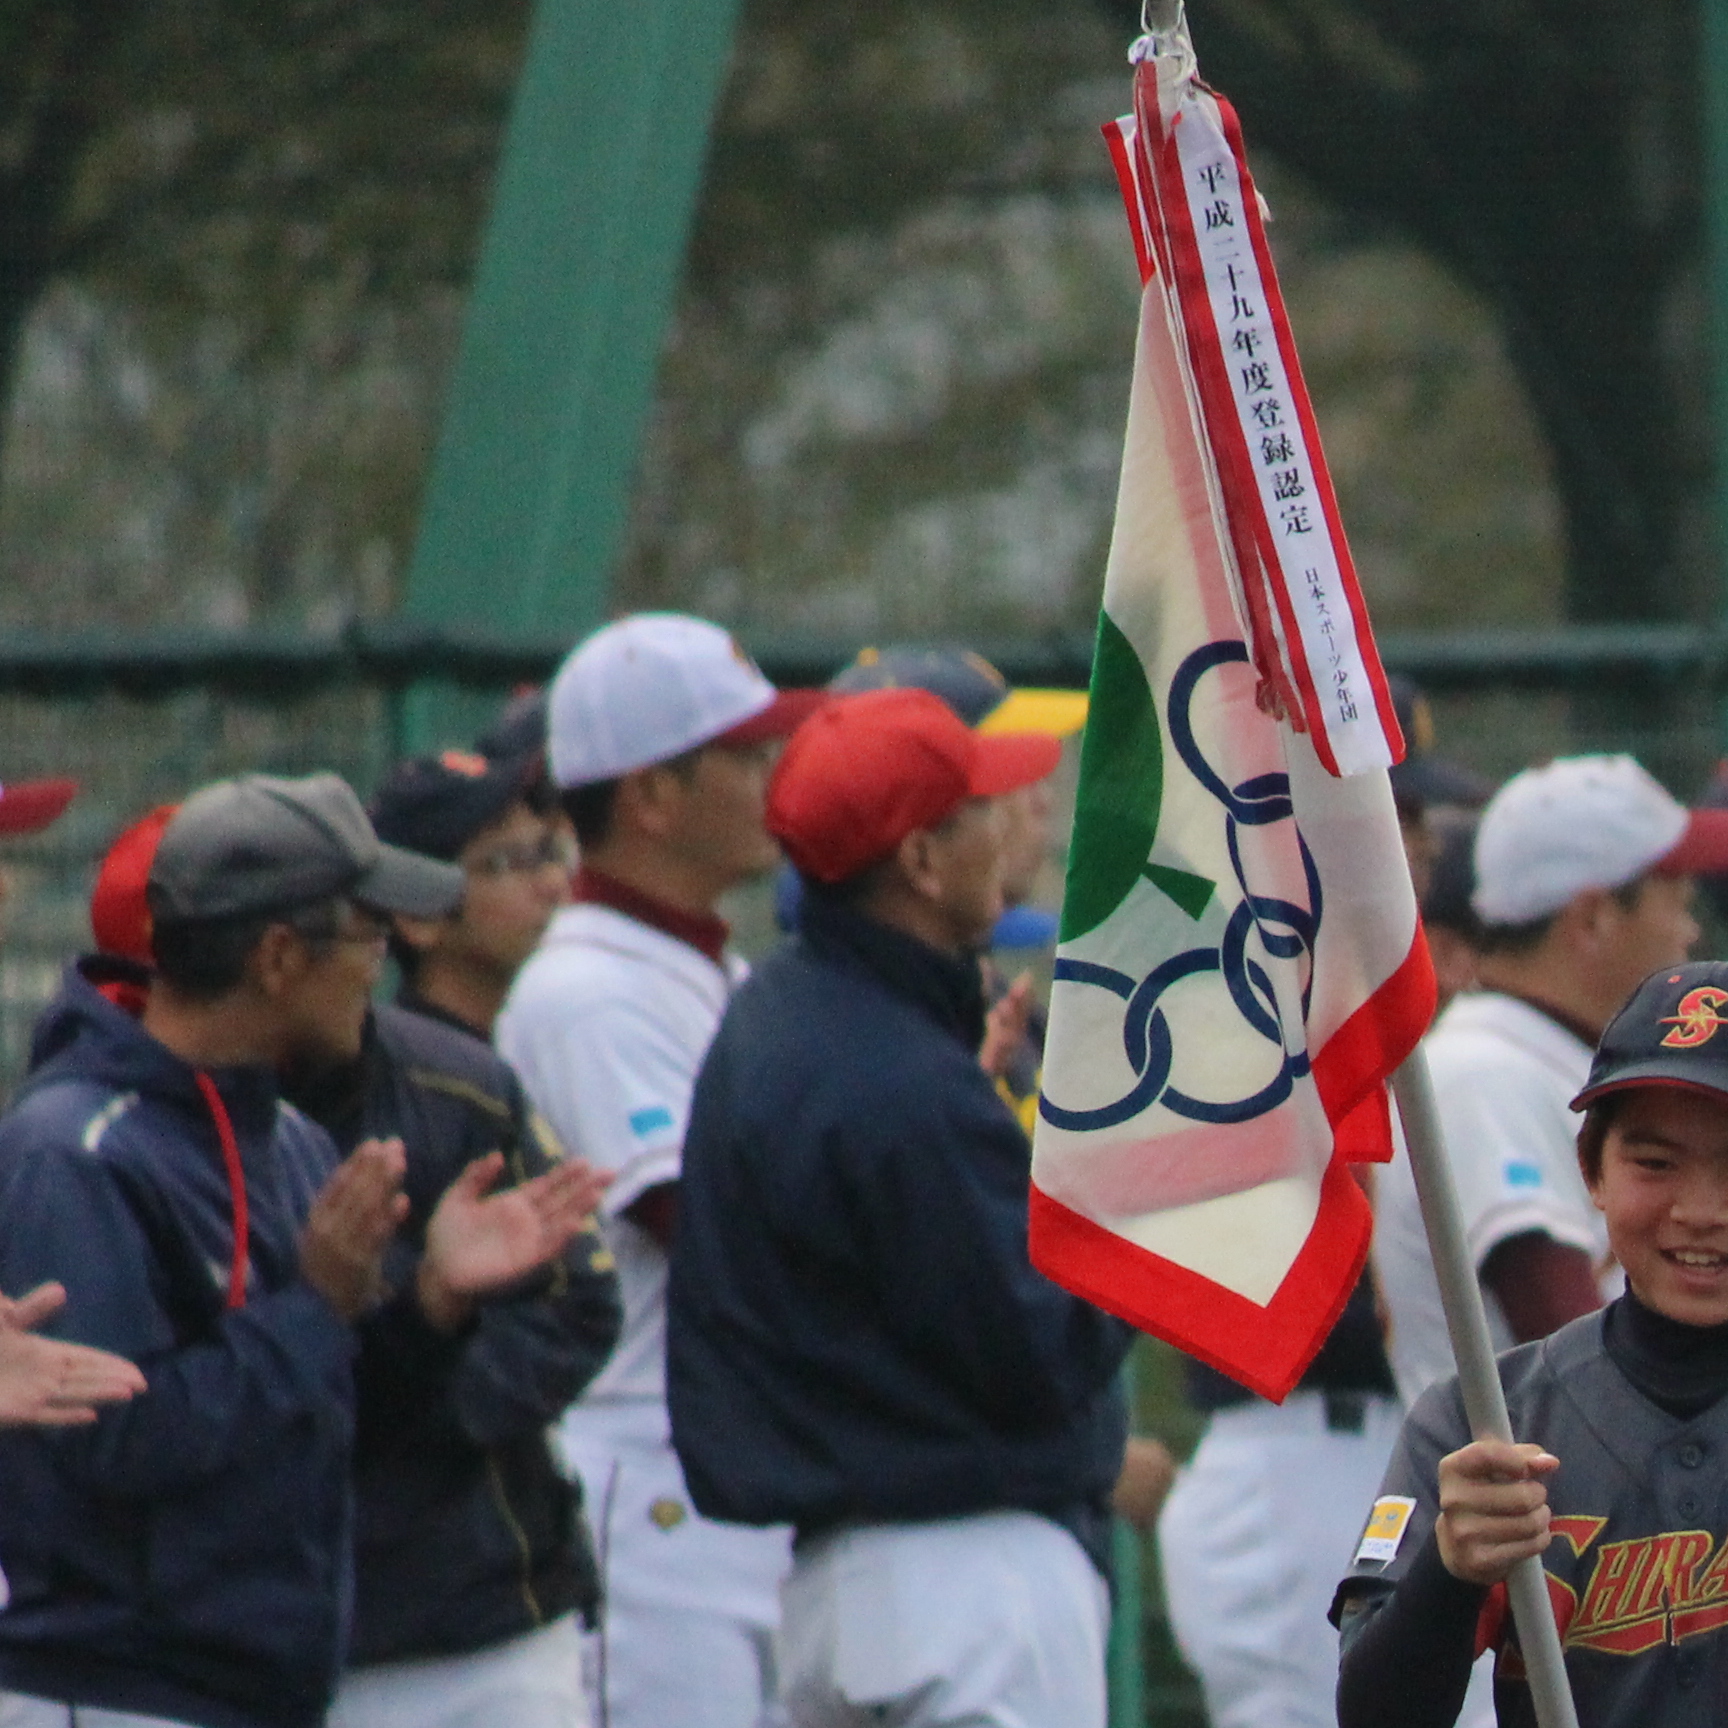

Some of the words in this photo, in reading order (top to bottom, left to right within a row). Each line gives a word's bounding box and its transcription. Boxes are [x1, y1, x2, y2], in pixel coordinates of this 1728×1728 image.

[1305, 566, 1358, 722] 日本スポーツ少年団
